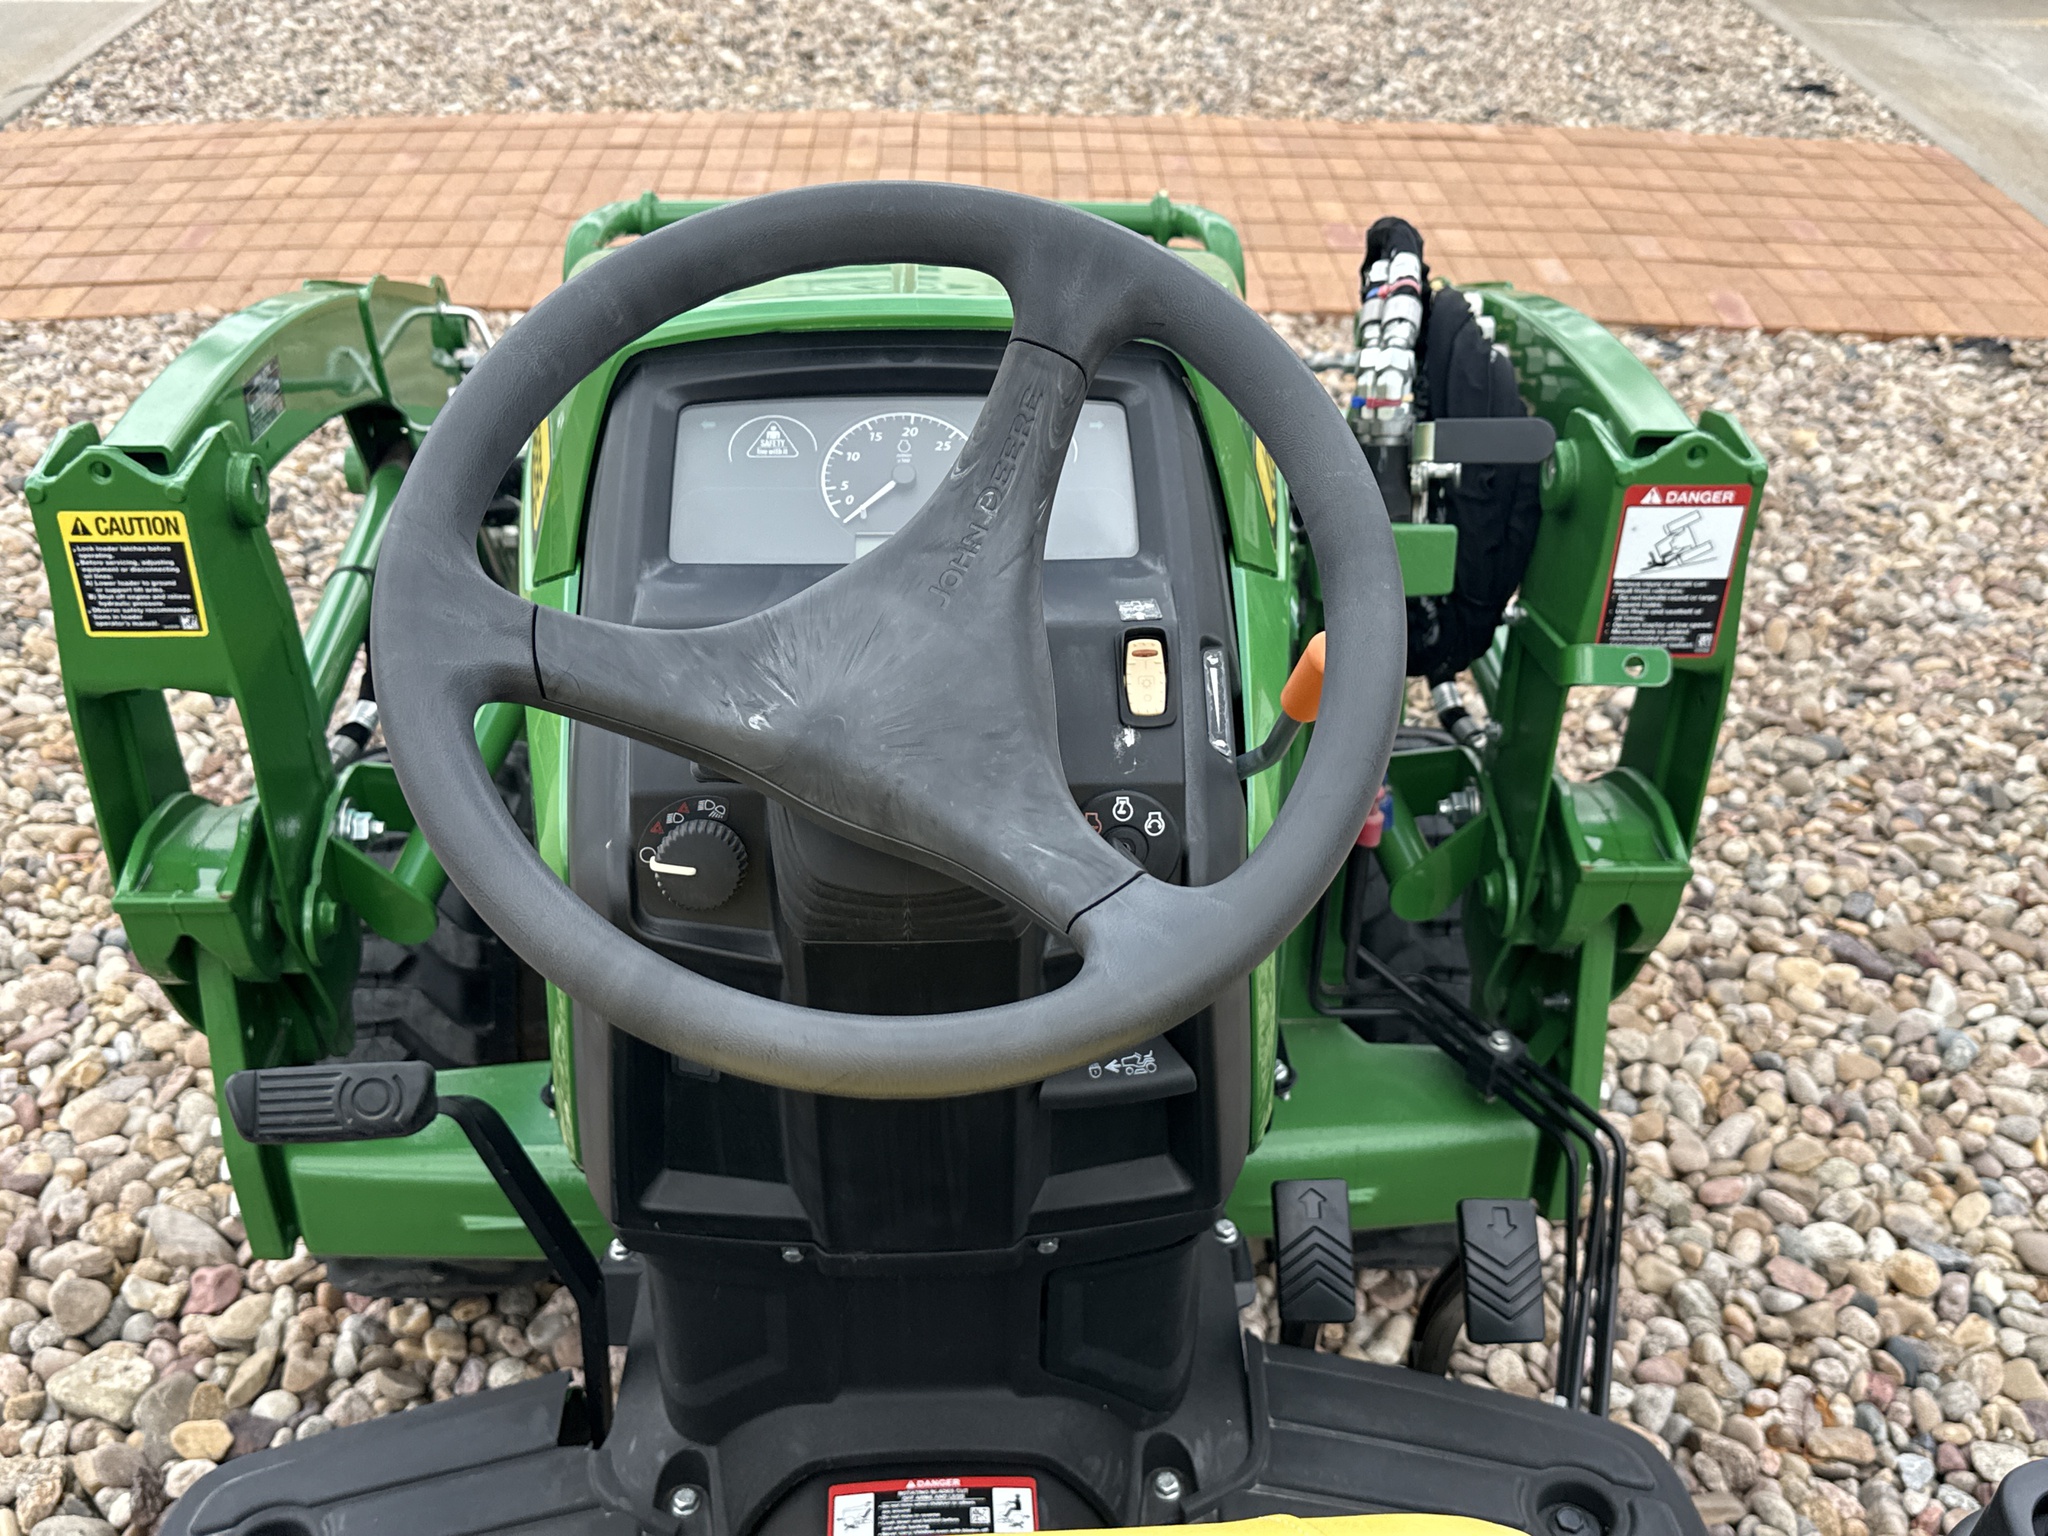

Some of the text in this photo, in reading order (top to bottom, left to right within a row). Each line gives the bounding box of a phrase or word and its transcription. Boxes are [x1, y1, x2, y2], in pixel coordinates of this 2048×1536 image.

[902, 427, 918, 436] 20
[870, 432, 882, 441] 15
[935, 441, 951, 451] 25
[846, 452, 860, 461] 10
[841, 481, 849, 490] 5
[845, 495, 854, 505] 0
[928, 387, 1043, 610] JOHN DEERE
[1665, 490, 1736, 504] DANGER
[95, 517, 181, 535] CAUTION
[916, 1479, 960, 1487] DANGER
